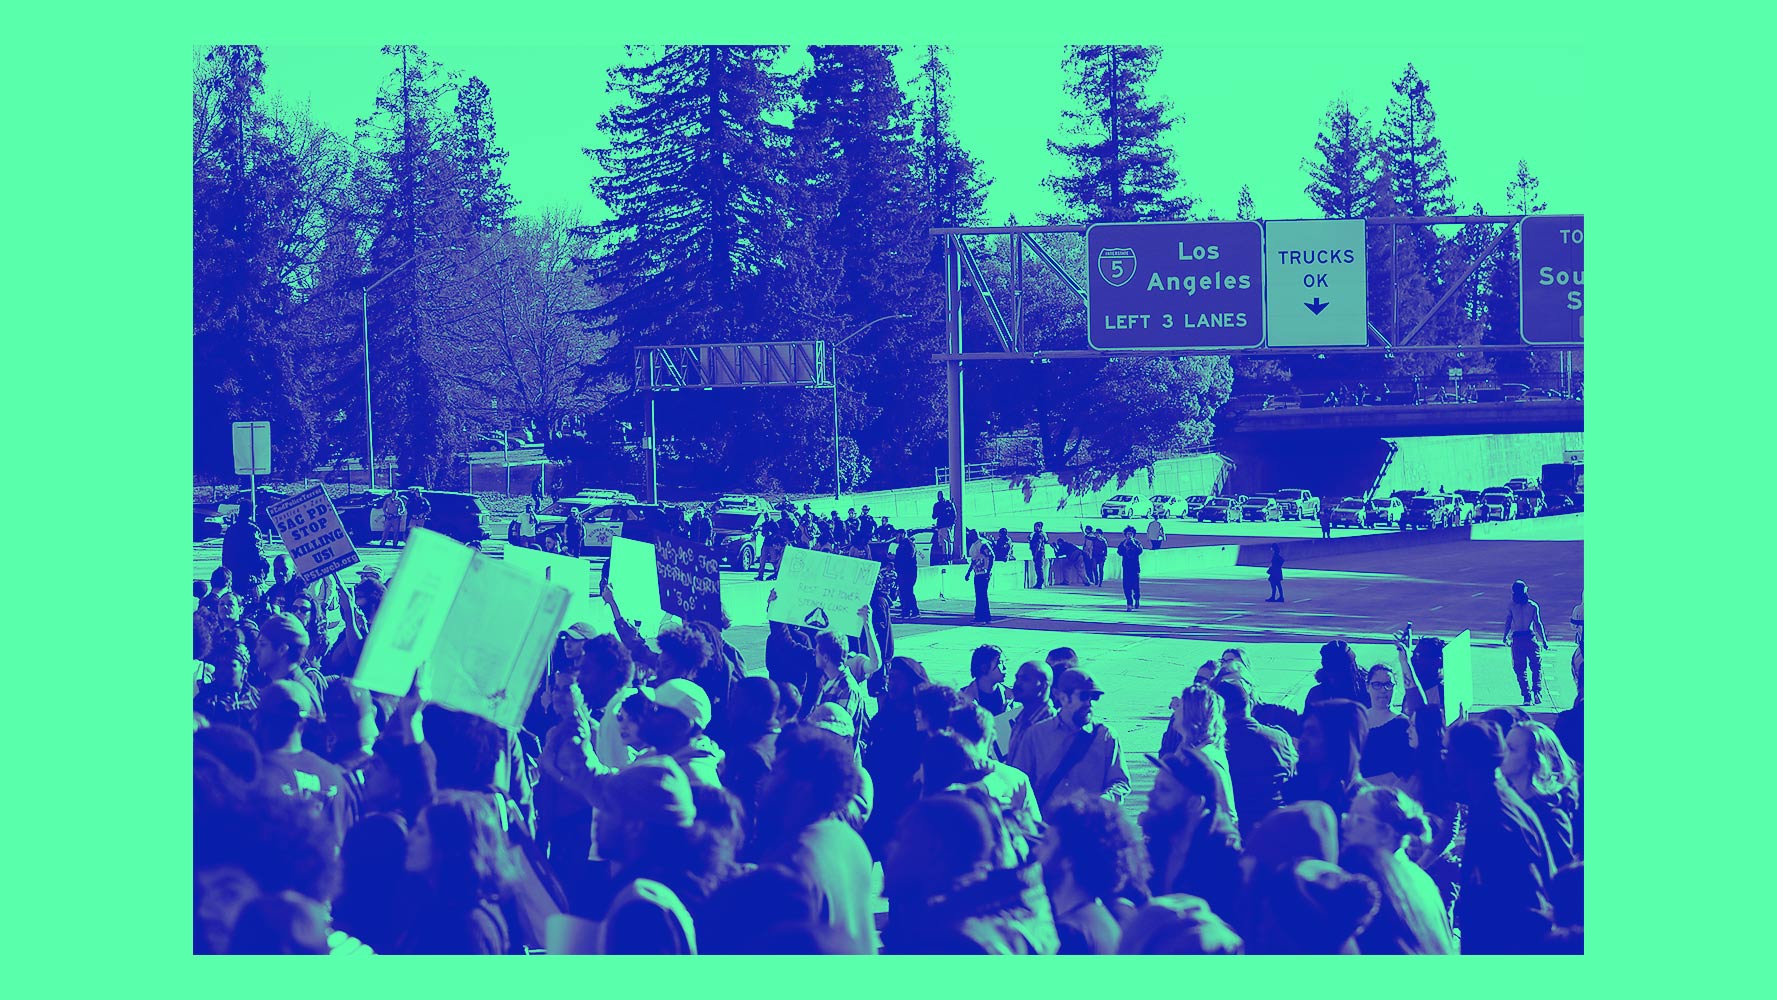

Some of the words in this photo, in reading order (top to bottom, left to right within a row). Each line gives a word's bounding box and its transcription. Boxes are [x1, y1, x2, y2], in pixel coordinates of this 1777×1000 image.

[1559, 229, 1584, 244] TO
[1178, 241, 1220, 261] Los
[1277, 249, 1355, 265] TRUCKS
[1111, 260, 1124, 278] 5
[1146, 271, 1251, 297] Angeles
[1303, 273, 1329, 288] OK
[1567, 290, 1583, 310] S
[1104, 313, 1150, 329] LEFT
[1162, 313, 1174, 329] 3
[1184, 312, 1247, 329] LANES
[277, 513, 306, 533] SAC
[291, 517, 327, 541] STOP
[290, 527, 345, 559] KILLING
[312, 546, 334, 564] US!
